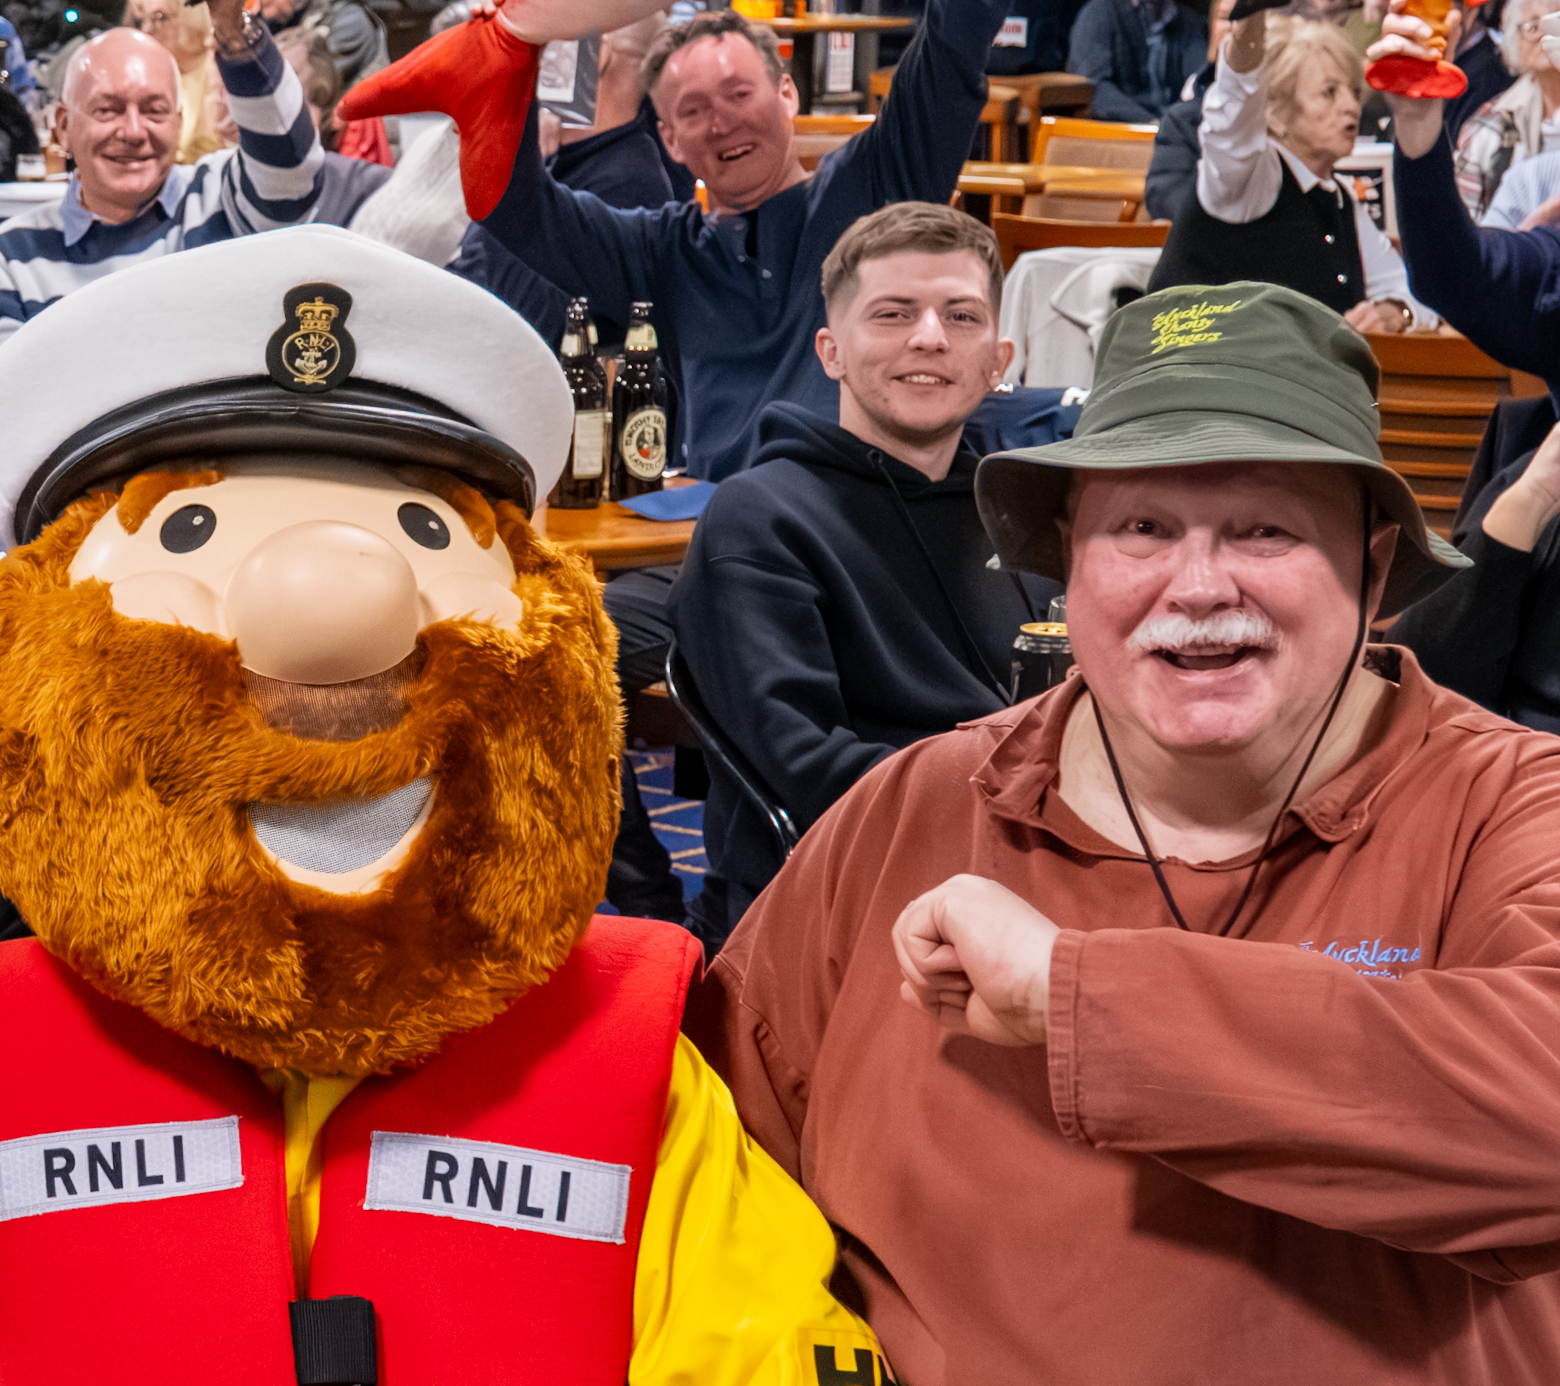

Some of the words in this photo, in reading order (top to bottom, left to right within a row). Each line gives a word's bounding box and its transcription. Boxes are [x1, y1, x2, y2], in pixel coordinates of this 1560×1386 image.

[1151, 318, 1217, 344] Shanty
[1151, 332, 1223, 355] Singers
[43, 1135, 185, 1198] RNLI
[422, 1149, 571, 1222] RNLI
